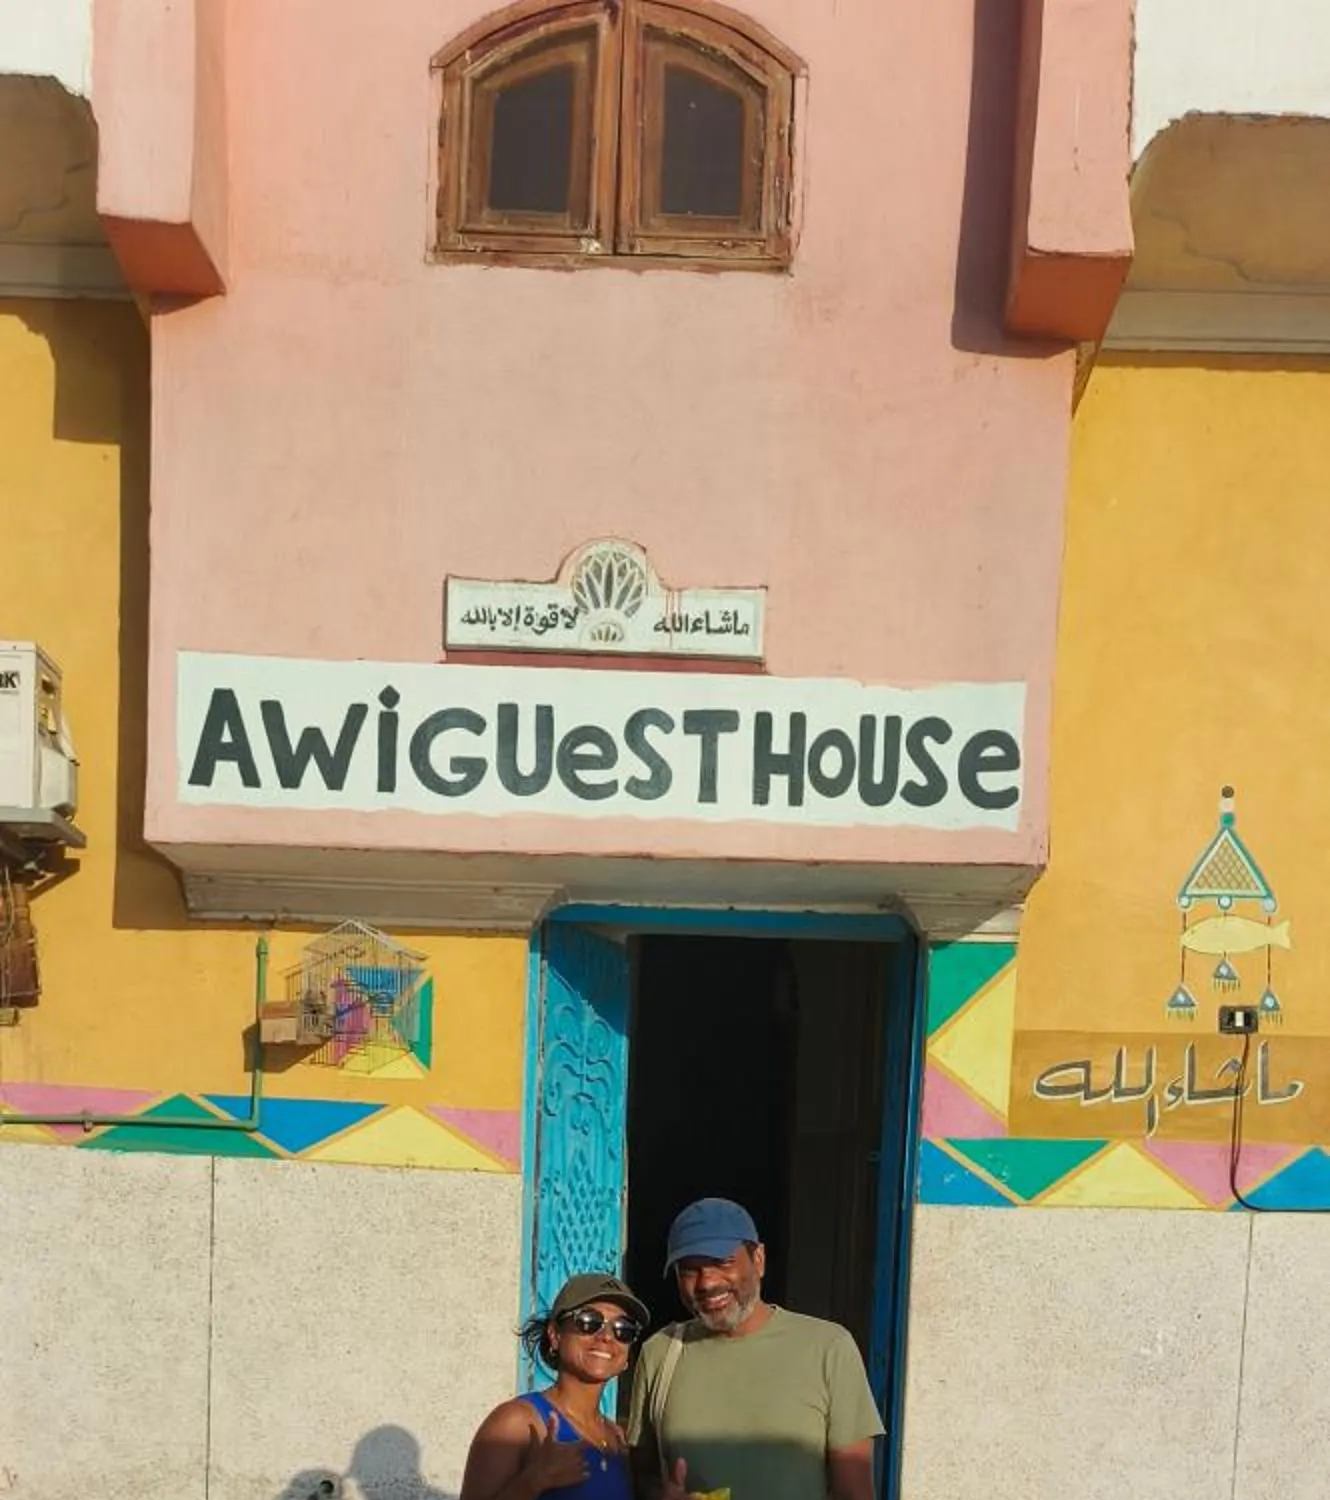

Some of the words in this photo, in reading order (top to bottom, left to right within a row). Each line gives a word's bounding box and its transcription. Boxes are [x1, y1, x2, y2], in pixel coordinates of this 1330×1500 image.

[460, 605, 497, 631] بالله
[523, 603, 559, 636] قوة
[1034, 1043, 1160, 1138] الله
